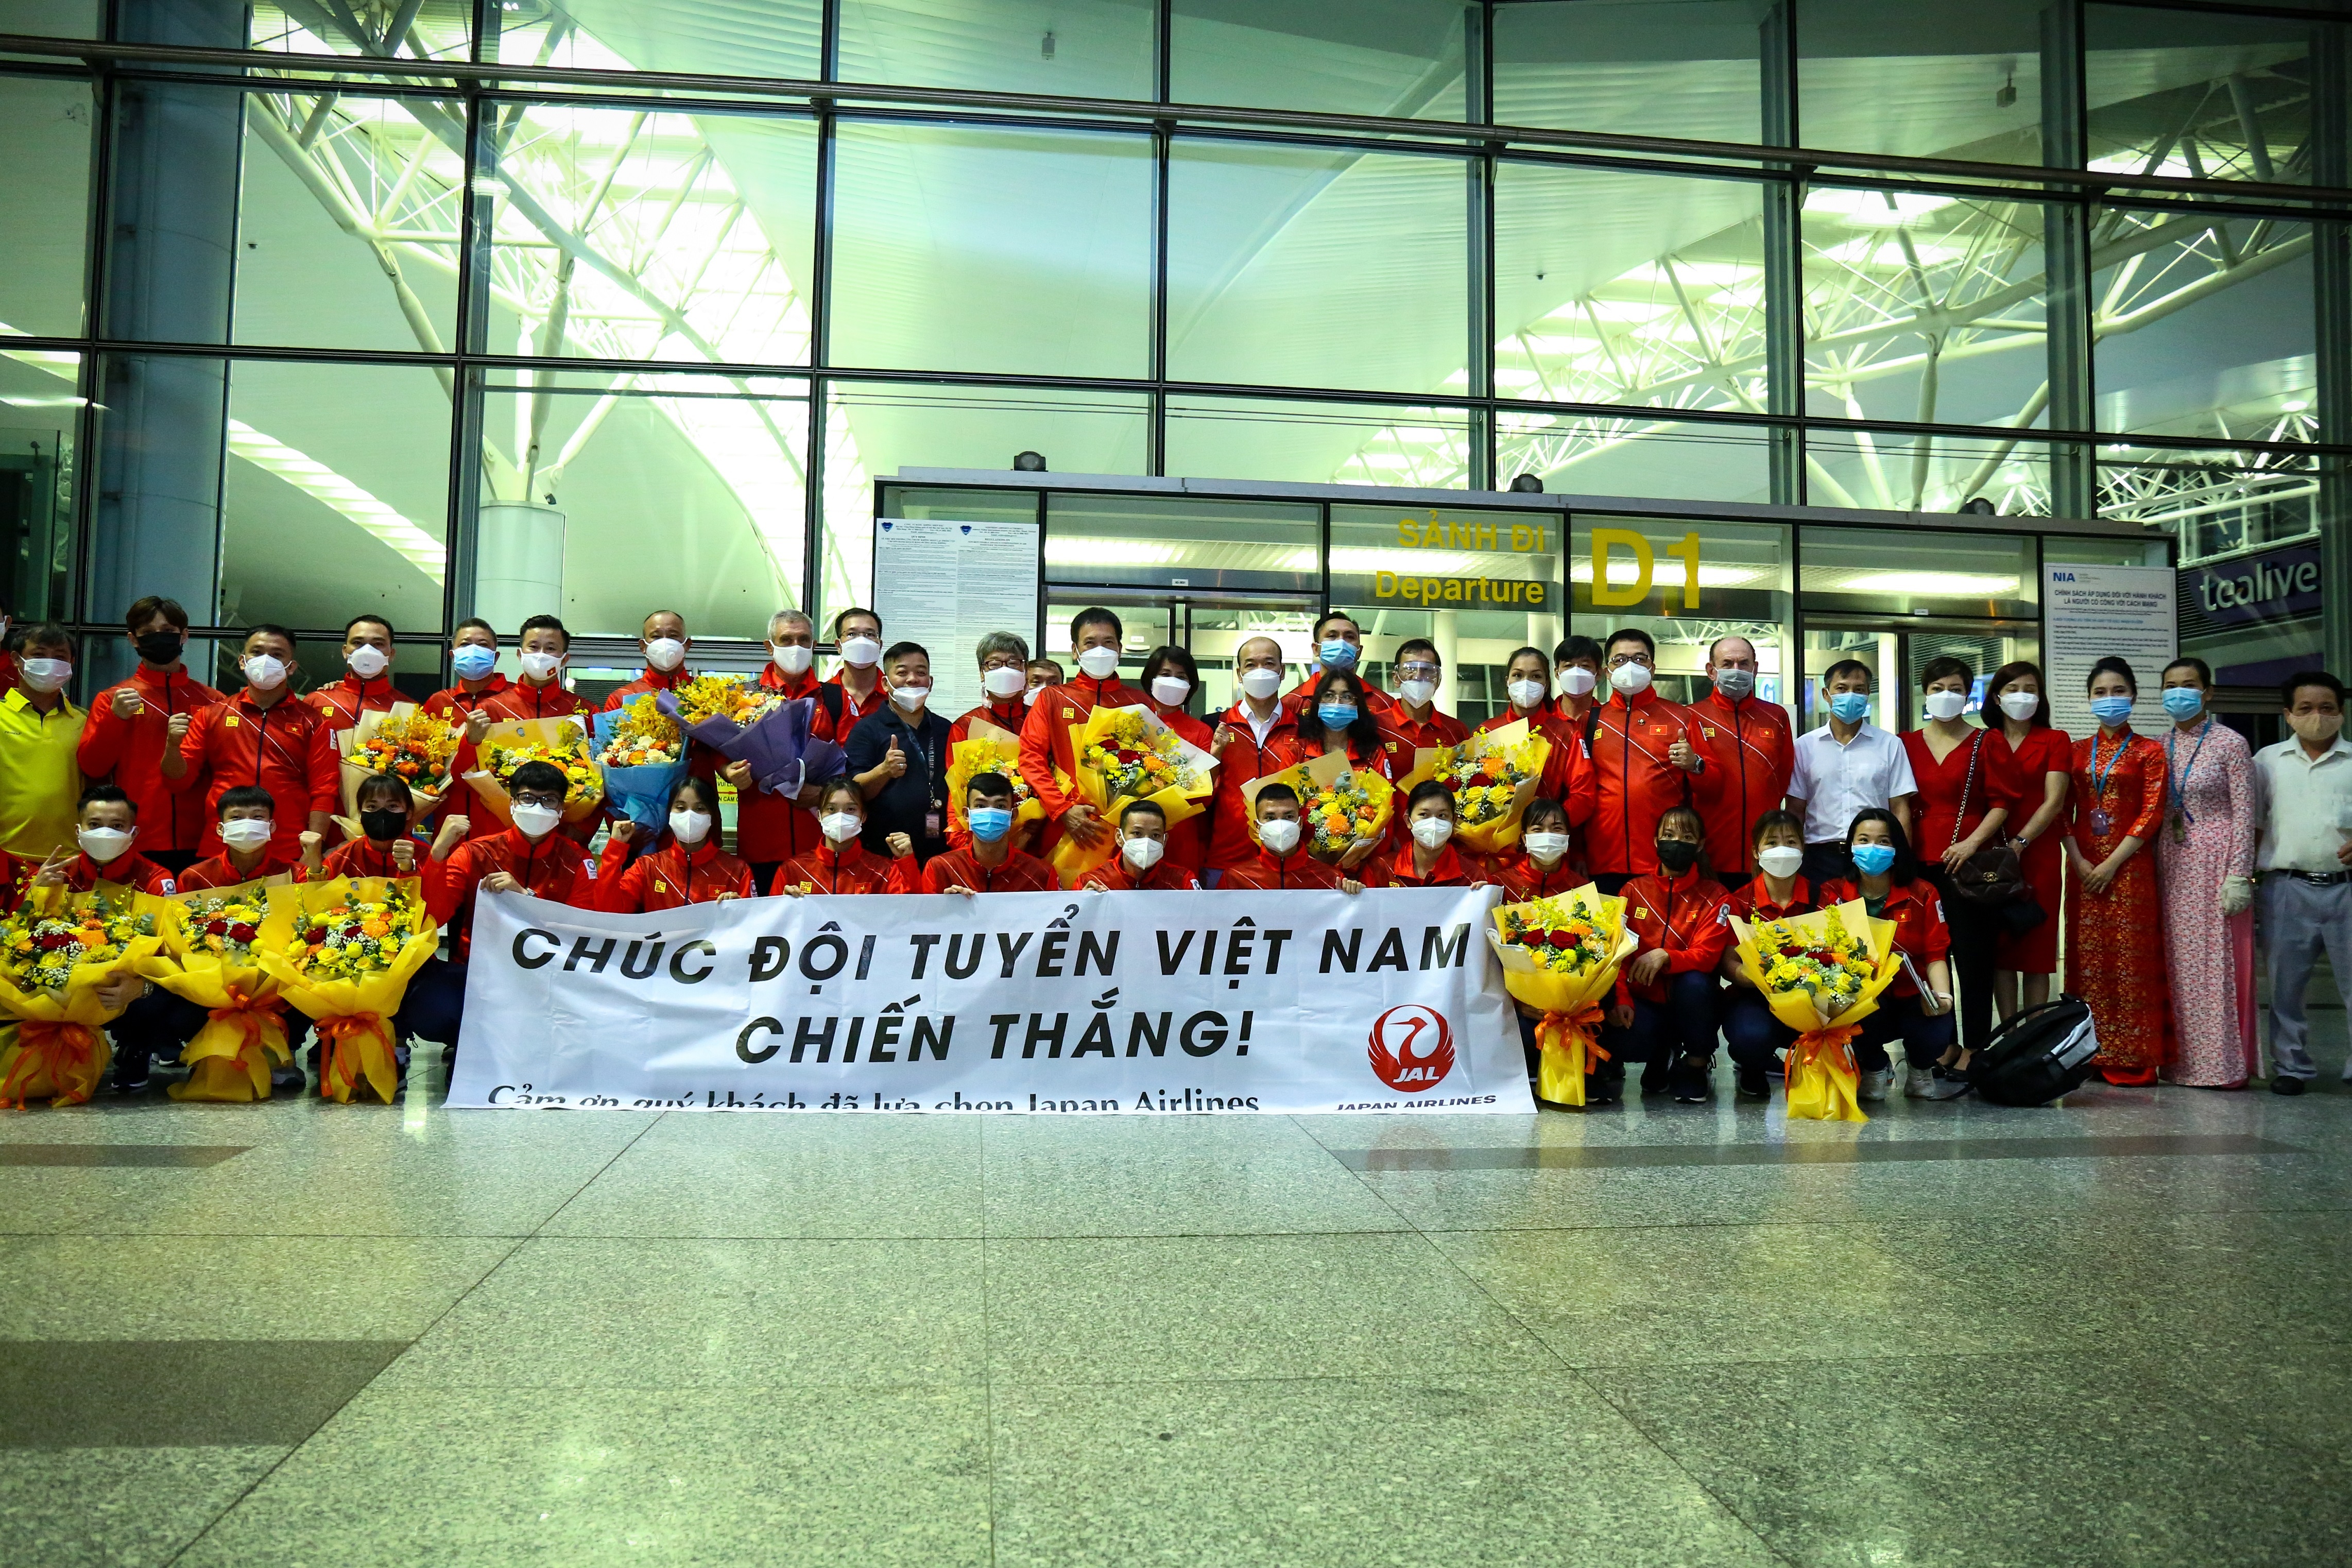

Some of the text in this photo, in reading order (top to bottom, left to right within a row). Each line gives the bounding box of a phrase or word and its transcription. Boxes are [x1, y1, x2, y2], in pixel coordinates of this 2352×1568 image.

[1398, 510, 1544, 553] SẢNH ĐI
[1592, 528, 1699, 609] D1
[2053, 573, 2075, 582] NIA
[2200, 562, 2317, 611] tealive
[1375, 571, 1544, 606] Departure
[512, 904, 1471, 994] CHÚC ĐỘI TUYỂN VIỆT NAM
[736, 987, 1253, 1063] CHIẾN THẮNG!
[1393, 1066, 1440, 1083] JAL
[1135, 1088, 1259, 1111] Airlines
[1334, 1095, 1497, 1111] JAPAN AIRLINES
